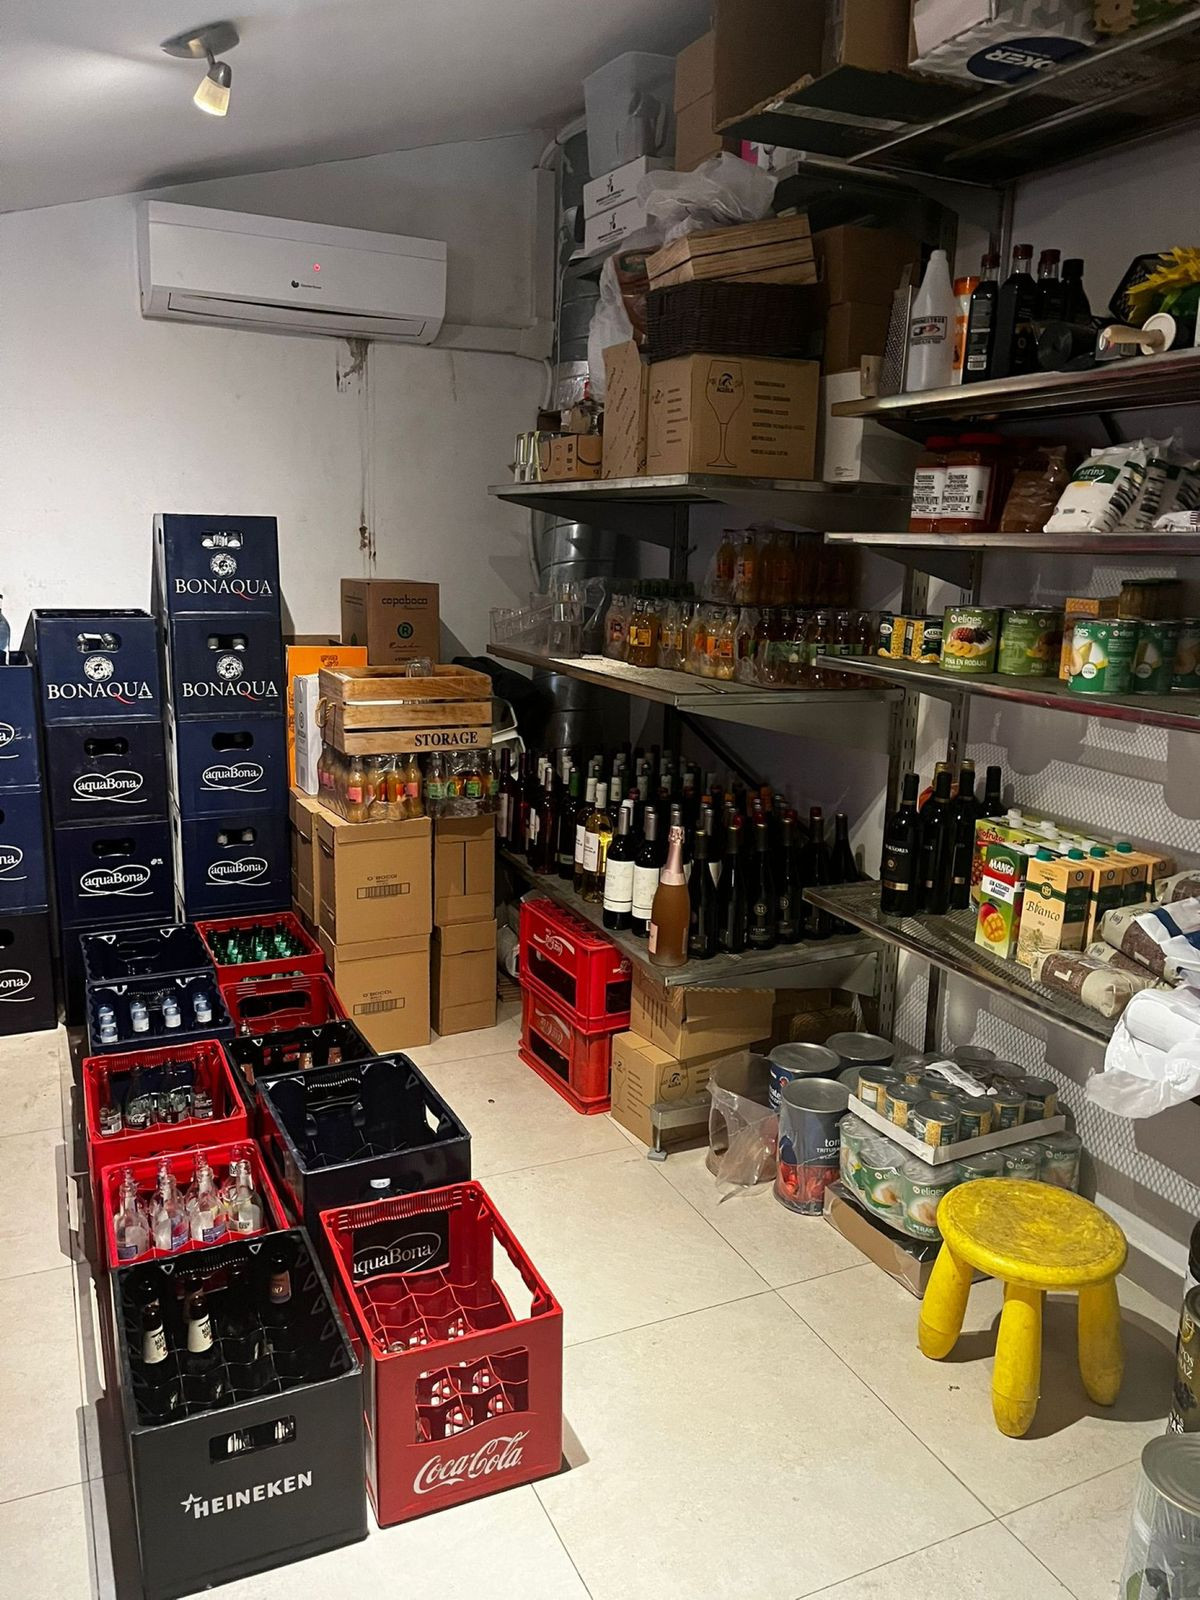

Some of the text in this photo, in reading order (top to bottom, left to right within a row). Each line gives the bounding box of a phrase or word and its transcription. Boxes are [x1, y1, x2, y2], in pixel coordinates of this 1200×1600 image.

[175, 578, 274, 600] BONAQUA
[958, 614, 982, 625] eliges
[47, 681, 153, 704] BONAQUA
[183, 680, 278, 701] BONAQUA
[414, 731, 478, 747] STORAGE
[989, 858, 1015, 876] MANGO
[1026, 899, 1061, 923] Blanco
[413, 1430, 530, 1494] Coca-Cola
[193, 1470, 312, 1519] HEINEKEN
